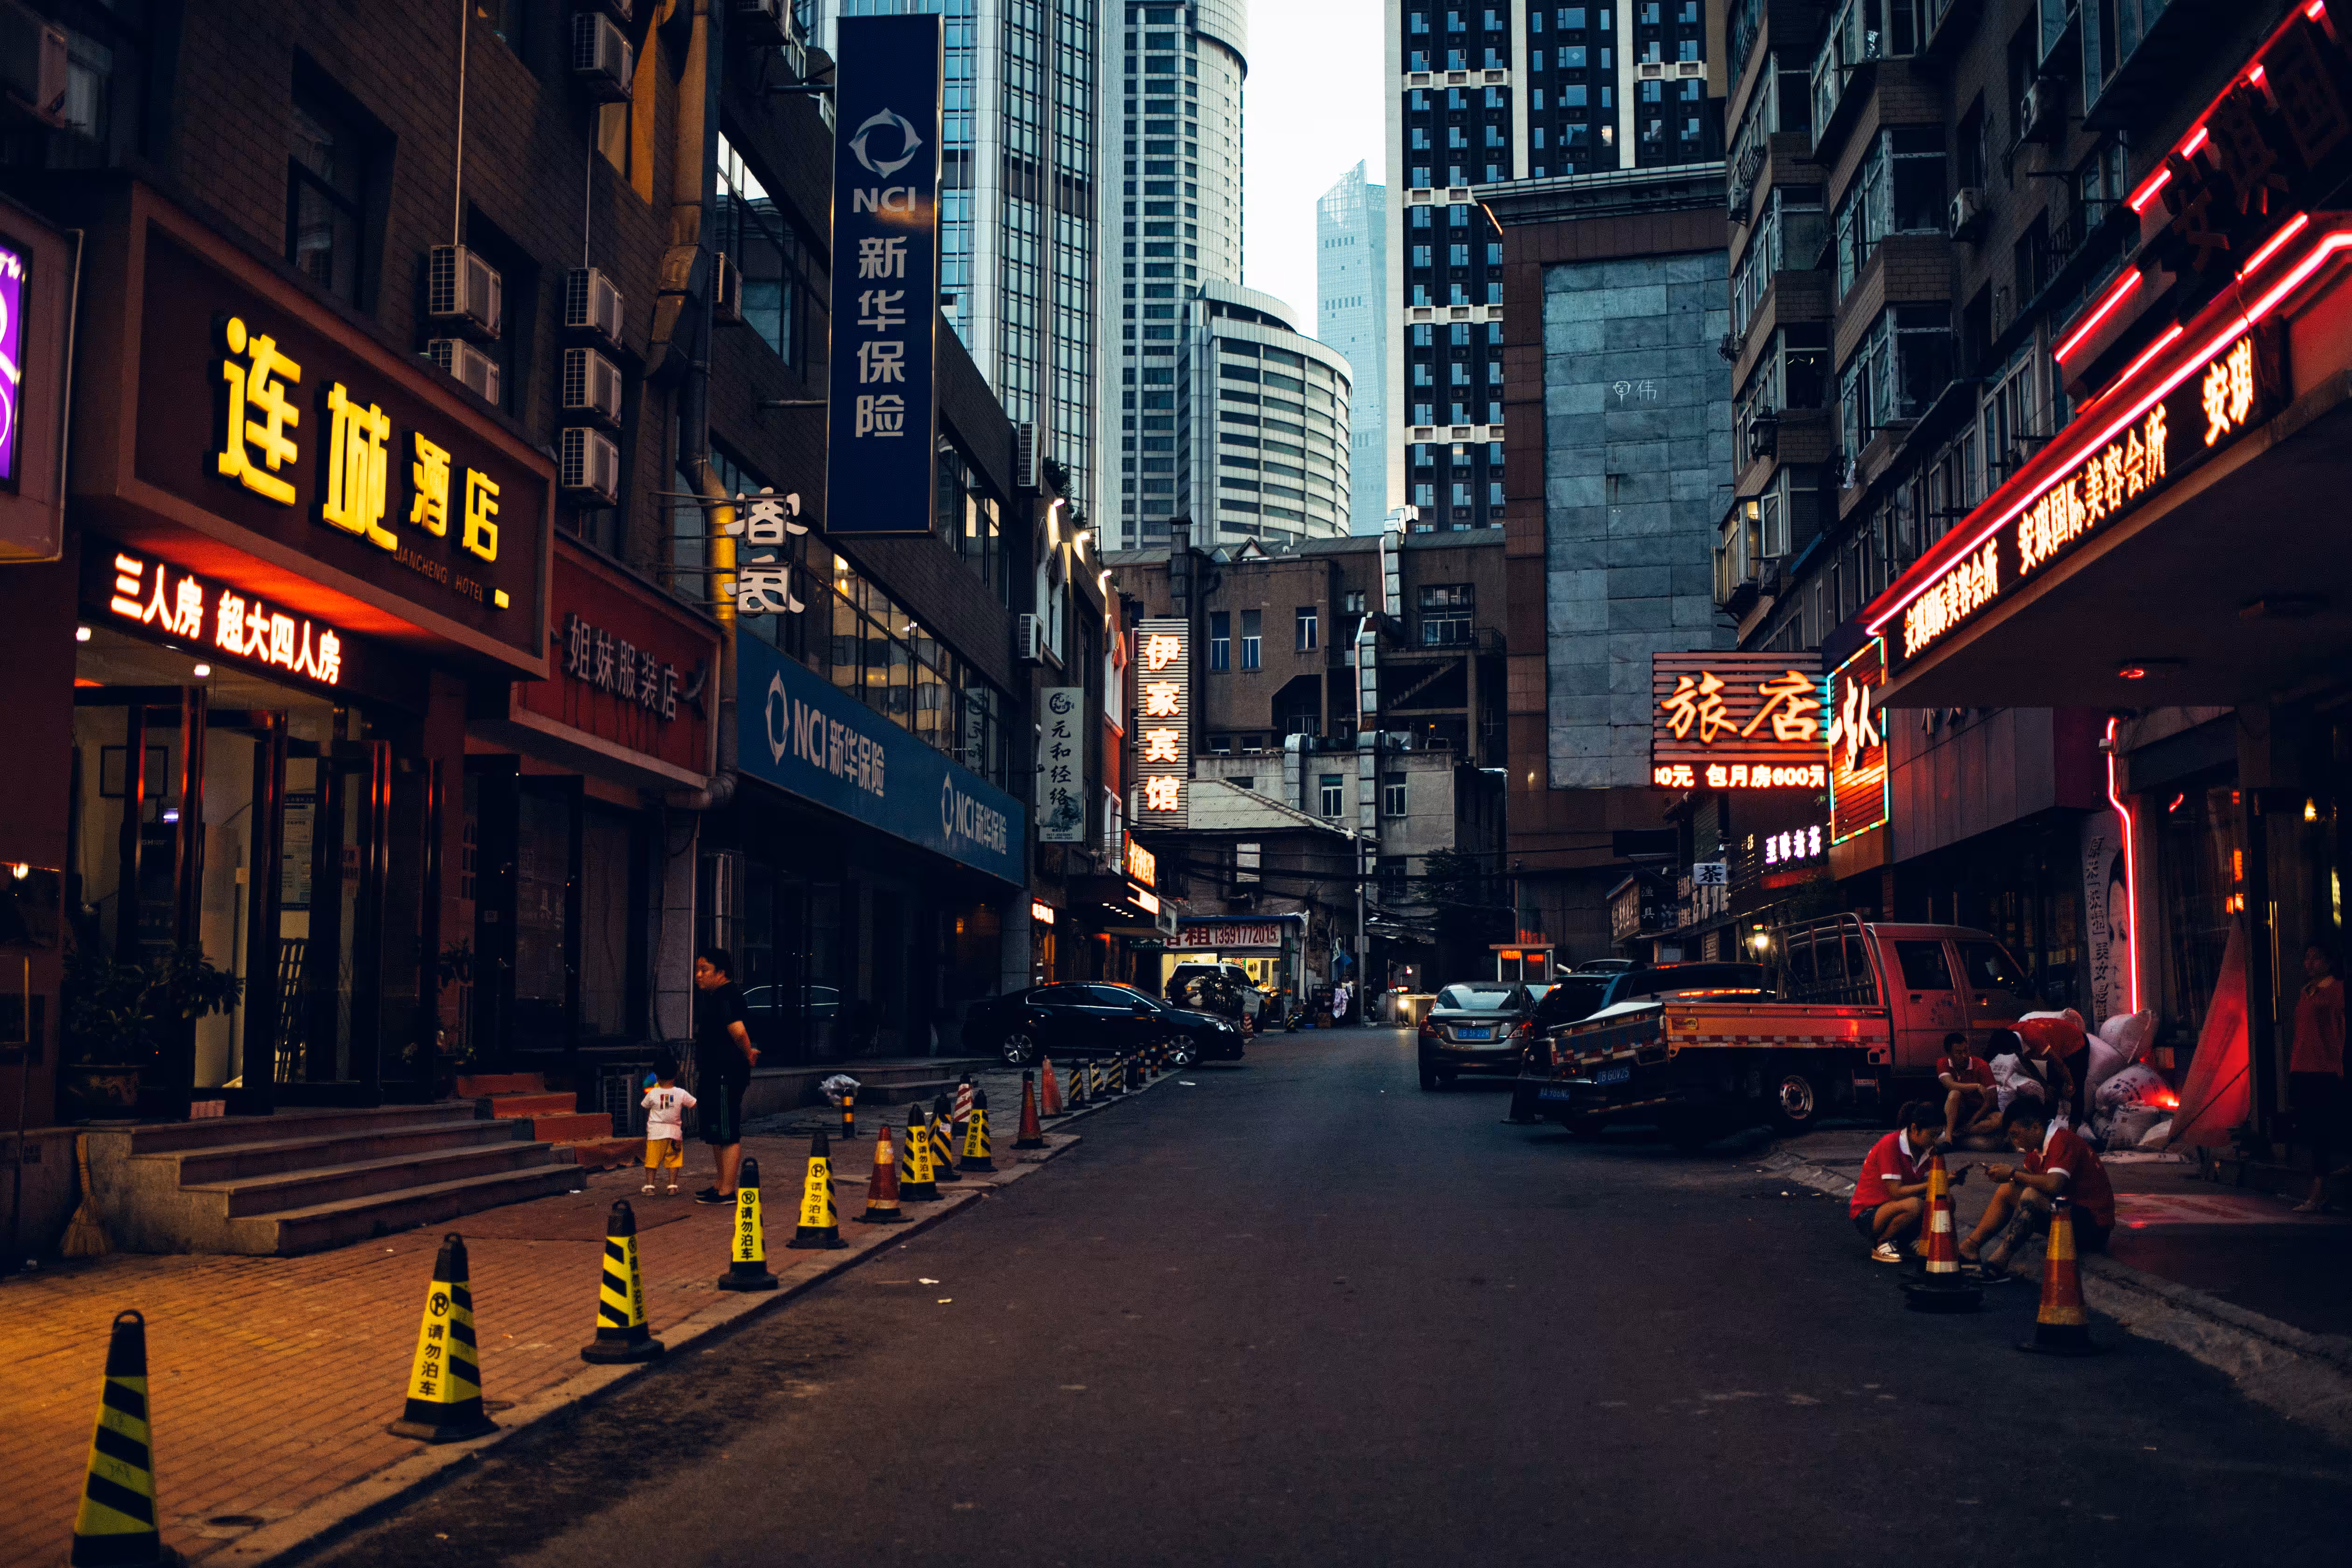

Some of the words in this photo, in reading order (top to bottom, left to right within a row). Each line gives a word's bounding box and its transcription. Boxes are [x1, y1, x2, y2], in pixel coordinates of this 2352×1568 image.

[854, 187, 915, 213] NCI
[855, 236, 907, 437] 新华保险
[1635, 379, 1657, 402] 伟
[218, 317, 499, 562] 连城酒店
[2018, 403, 2167, 574] 安琪国际美容会所
[112, 553, 203, 639] 三人房
[216, 589, 341, 685] 超大四人房
[569, 614, 679, 721] 姐妹服装店
[1145, 634, 1181, 811] 伊家宾馆
[1660, 670, 1820, 743] 旅店
[793, 698, 826, 769] NCI
[829, 719, 884, 798] 新华保险
[1050, 720, 1071, 806] 元和经络
[1655, 764, 1694, 788] 0元
[956, 791, 974, 839] NCI
[976, 802, 1007, 855] 新华保险
[1699, 865, 1723, 882] 茶
[918, 1146, 930, 1181] 请勿泊车
[966, 1126, 979, 1155] 请勿泊车
[741, 1207, 754, 1260] 请勿泊车
[807, 1183, 822, 1225] 请勿泊车
[418, 1324, 444, 1396] 请勿泊车
